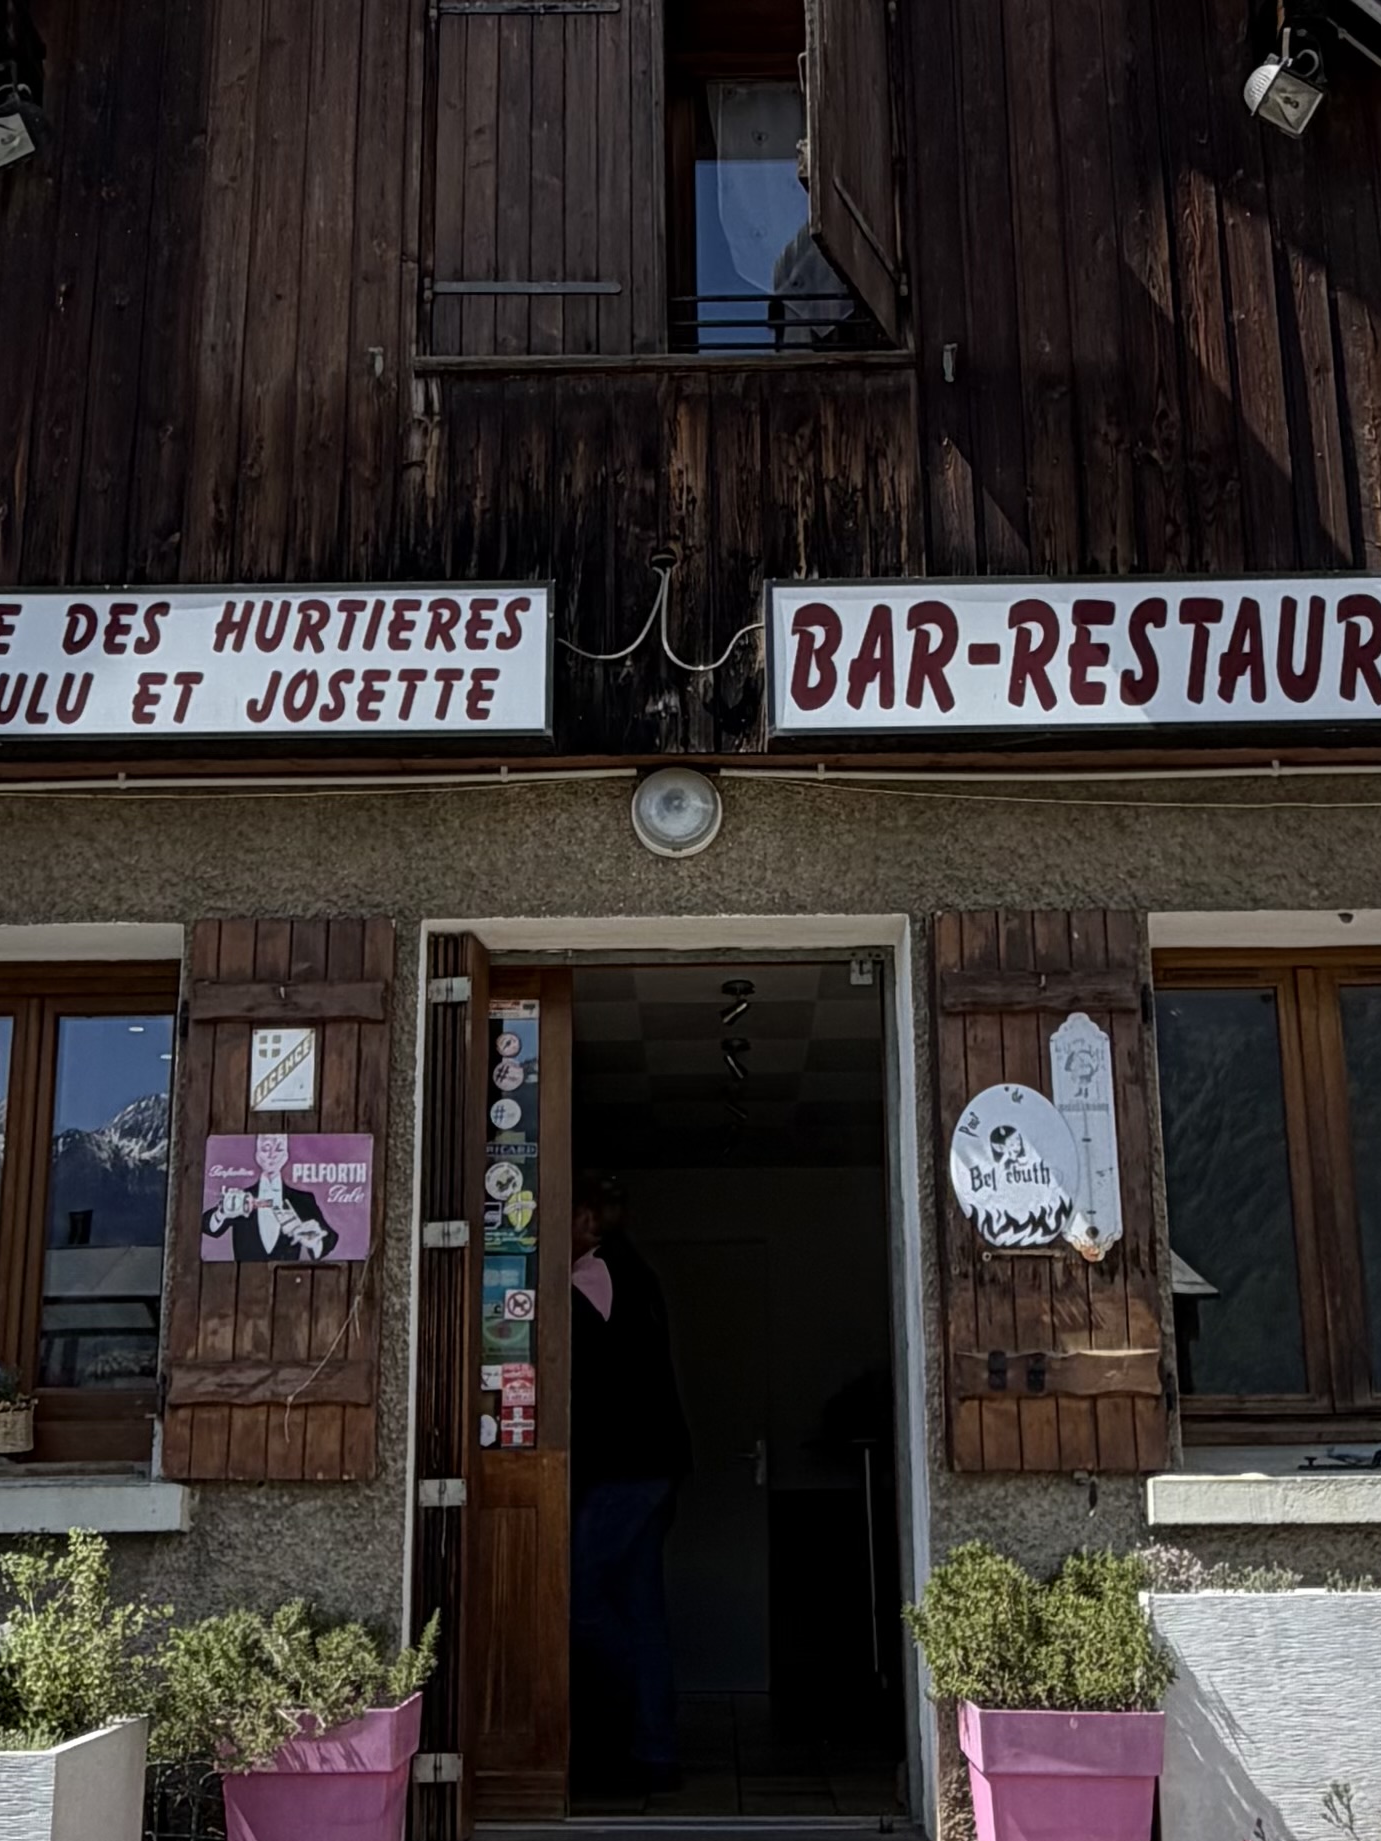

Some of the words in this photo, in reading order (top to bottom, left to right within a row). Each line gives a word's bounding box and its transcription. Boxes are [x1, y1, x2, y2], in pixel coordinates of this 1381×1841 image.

[62, 601, 172, 655] DES
[213, 597, 532, 655] HURTIERES
[132, 671, 204, 725] ET
[246, 667, 501, 723] JOSETTE
[255, 1036, 311, 1104] LICENCE
[292, 1163, 367, 1183] PELFORTH
[970, 1159, 1052, 1193] Belebuth
